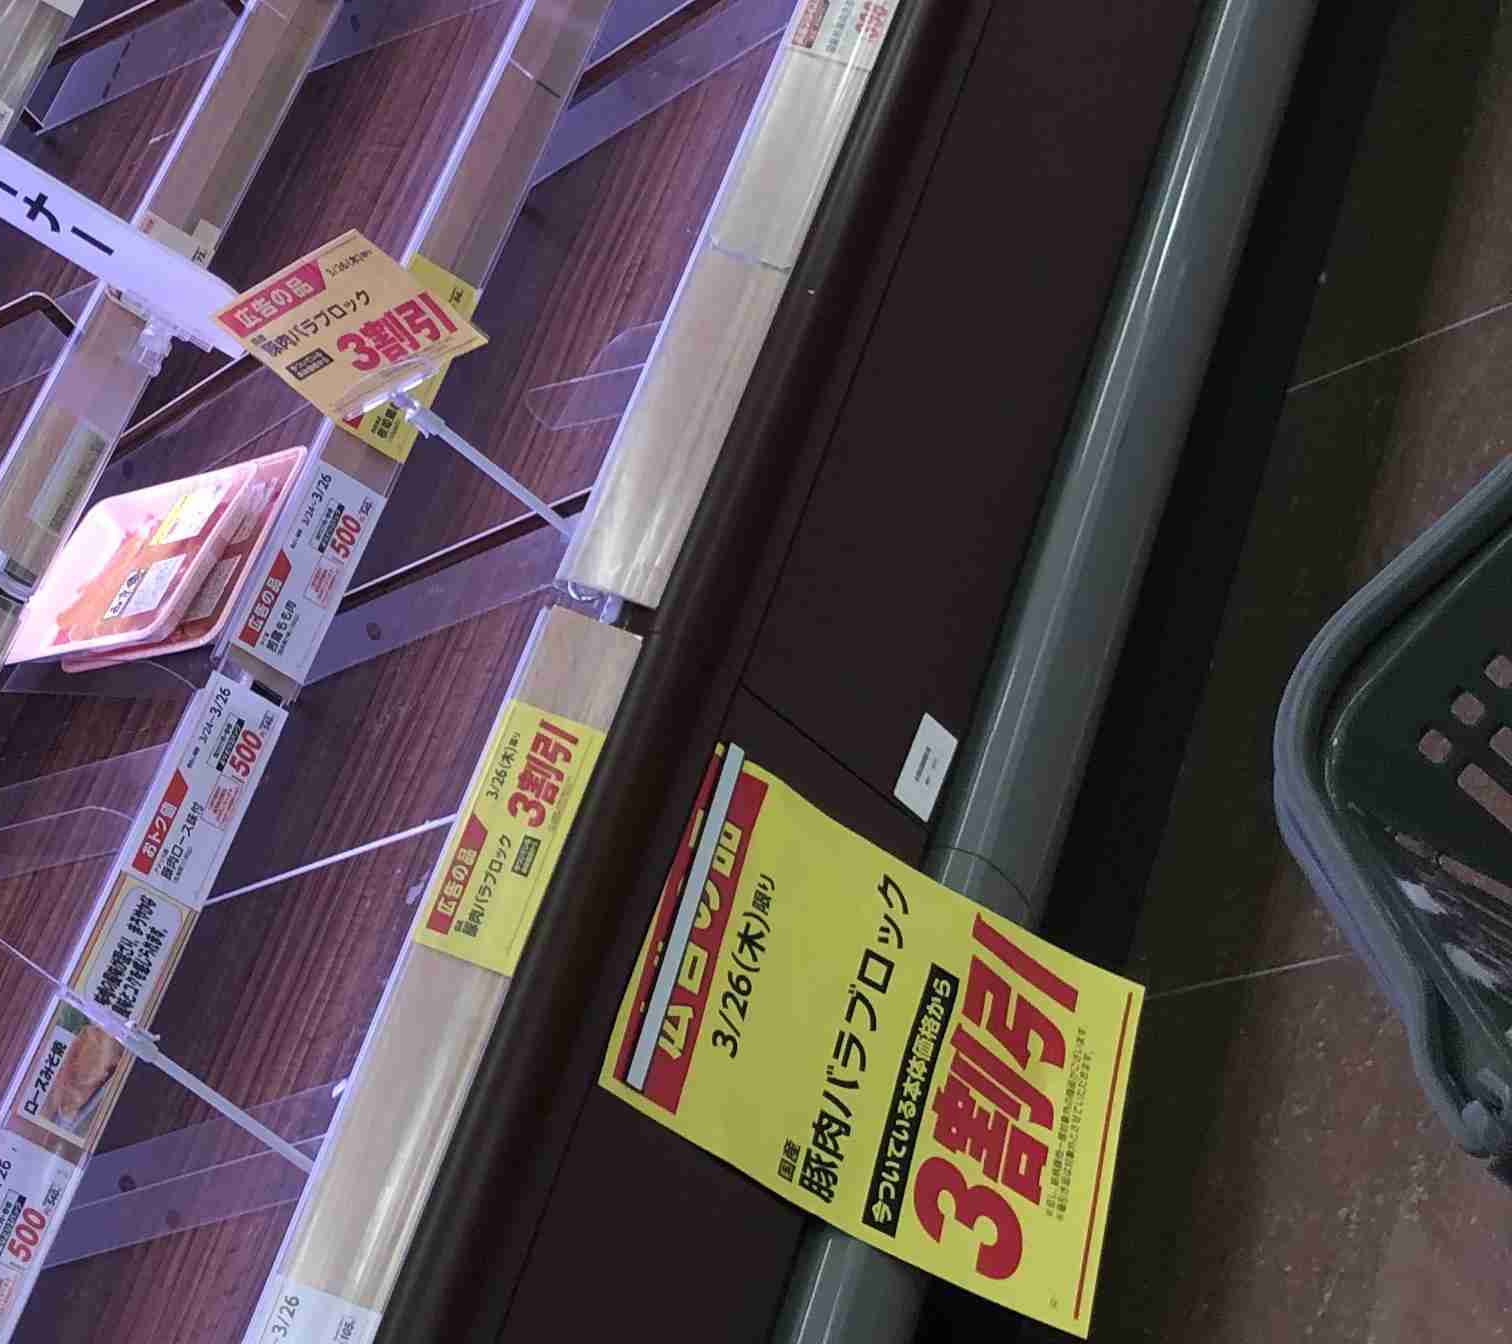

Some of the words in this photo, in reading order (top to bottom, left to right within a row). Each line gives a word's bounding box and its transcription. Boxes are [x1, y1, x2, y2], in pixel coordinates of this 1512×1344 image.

[232, 273, 316, 330] 広告の品
[333, 285, 457, 384] 3割引
[326, 512, 364, 559] 500
[246, 574, 284, 632] 広告の品
[264, 599, 298, 652] 若鶏もも肉
[226, 725, 267, 778] 500
[502, 718, 581, 830] 3割引
[159, 800, 205, 880] 豚肉ロース味付
[436, 844, 477, 916] 広告の品
[460, 832, 514, 936] 豚肉バラブロック
[796, 873, 909, 1204] 豚肉バラブロック
[872, 972, 954, 1226] 今ついている本体価格から
[914, 913, 1081, 1282] 3割引
[778, 1138, 801, 1181] 国産
[5, 1204, 51, 1263] 500
